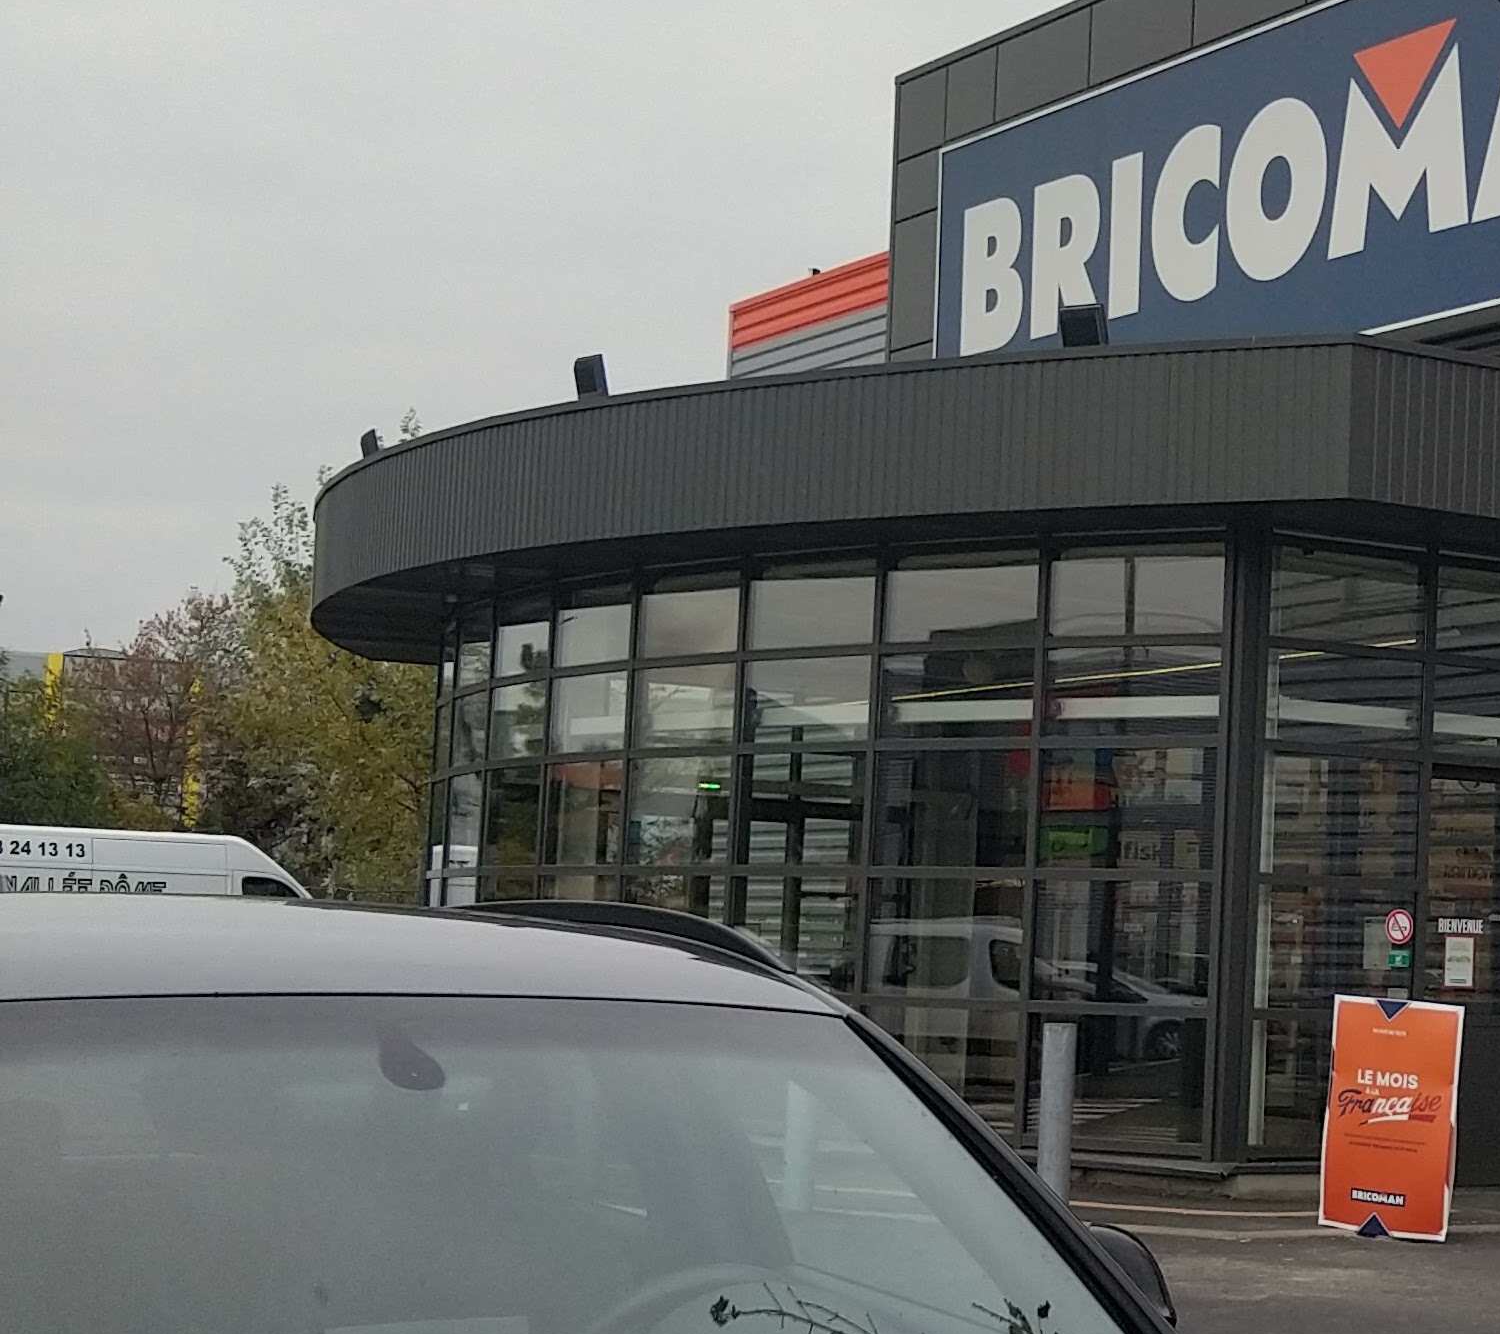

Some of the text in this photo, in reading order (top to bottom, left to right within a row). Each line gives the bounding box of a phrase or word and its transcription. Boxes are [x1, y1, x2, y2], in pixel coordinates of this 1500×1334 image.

[10, 840, 31, 855] 24
[38, 842, 58, 856] 13
[66, 843, 85, 858] 13
[1438, 918, 1484, 933] BIENVENUE
[1358, 1069, 1418, 1089] LE MOIS
[1338, 1088, 1442, 1119] Française
[1352, 1189, 1404, 1206] BRICOMAN
